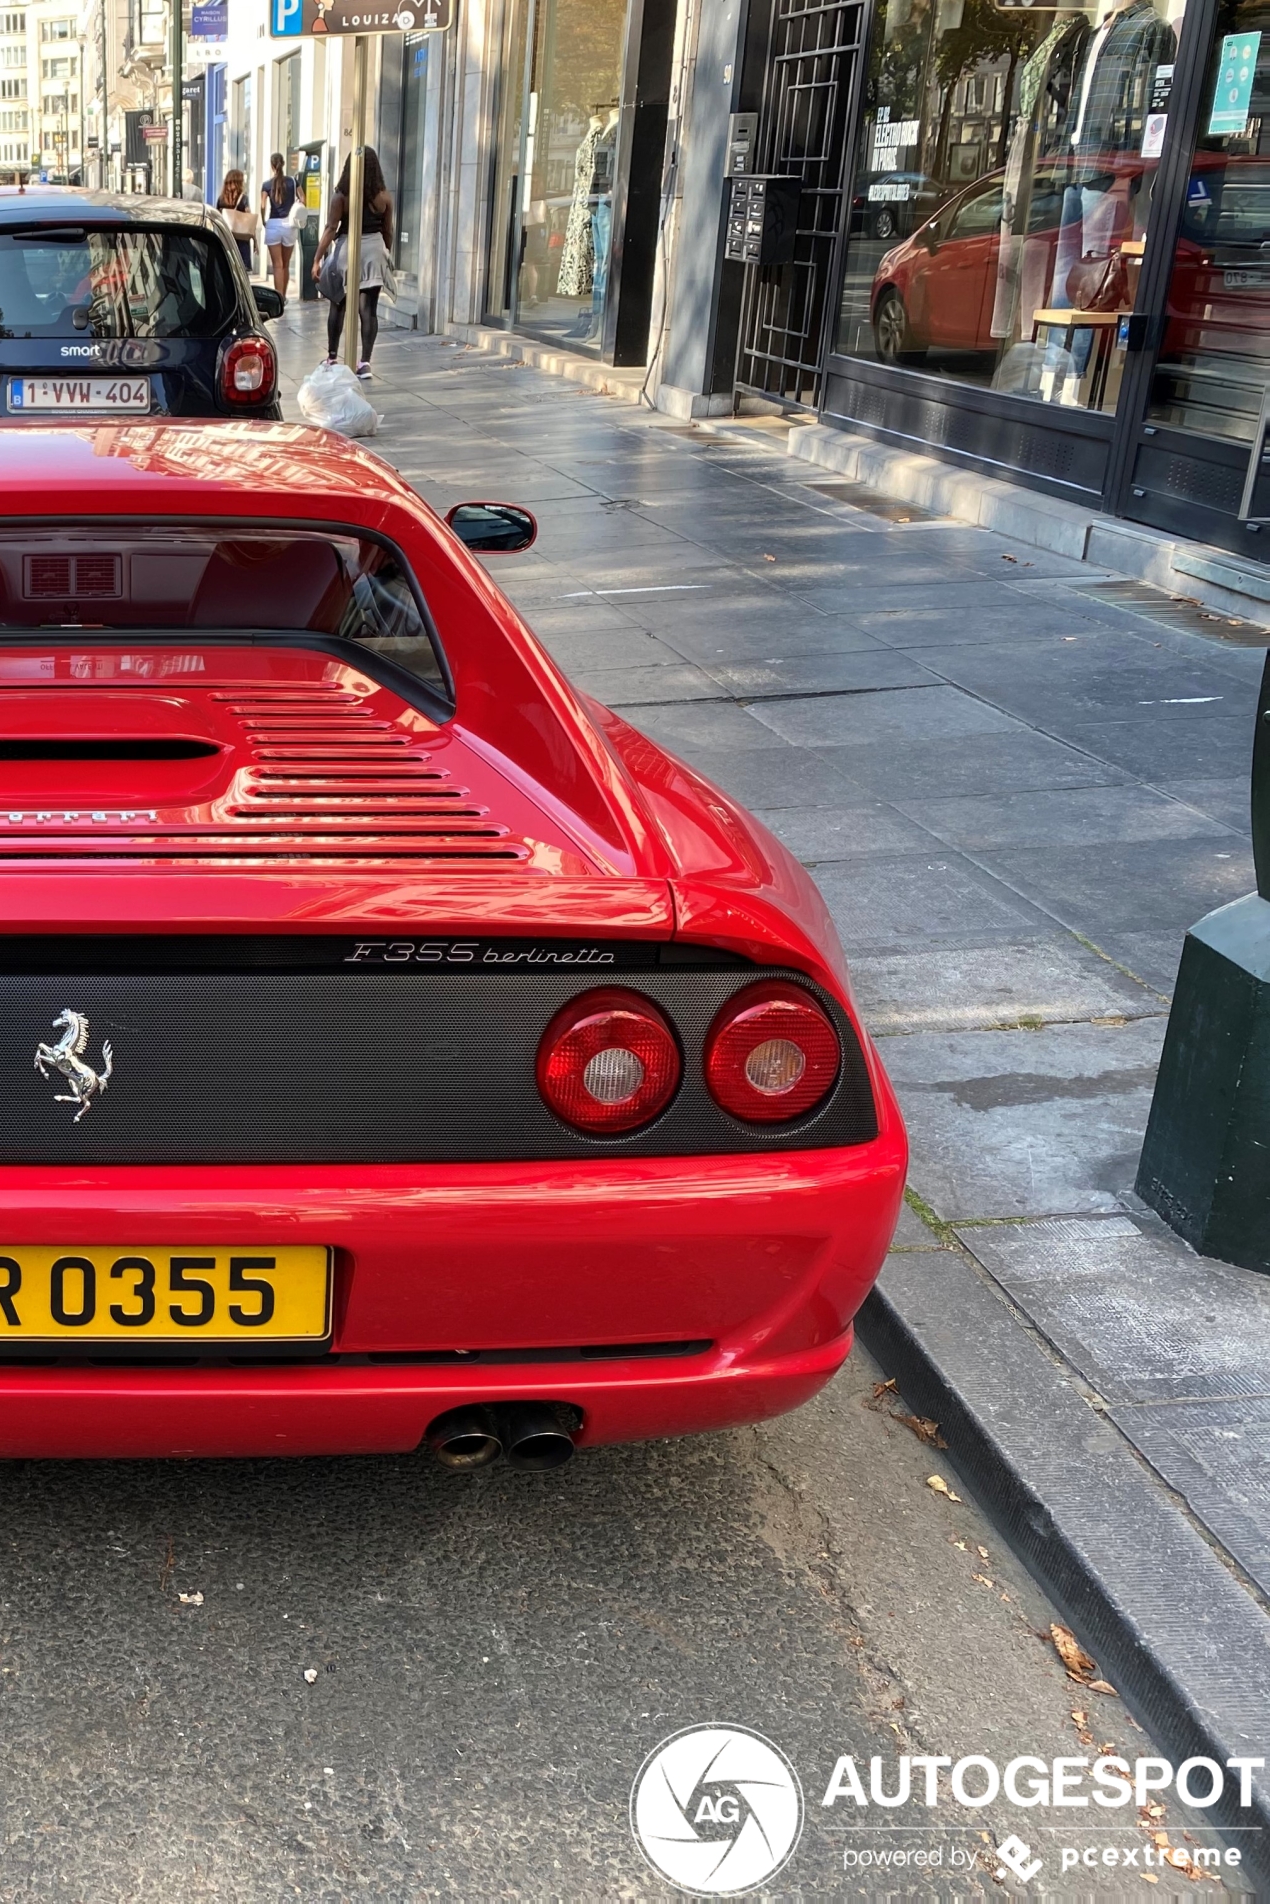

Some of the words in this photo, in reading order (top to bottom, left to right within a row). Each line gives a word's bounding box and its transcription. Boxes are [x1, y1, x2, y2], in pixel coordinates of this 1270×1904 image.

[277, 0, 299, 31] P
[60, 344, 101, 357] smart
[13, 395, 22, 405] B
[344, 943, 480, 962] F355
[482, 947, 616, 964] berlinetta
[49, 1256, 277, 1327] 0355
